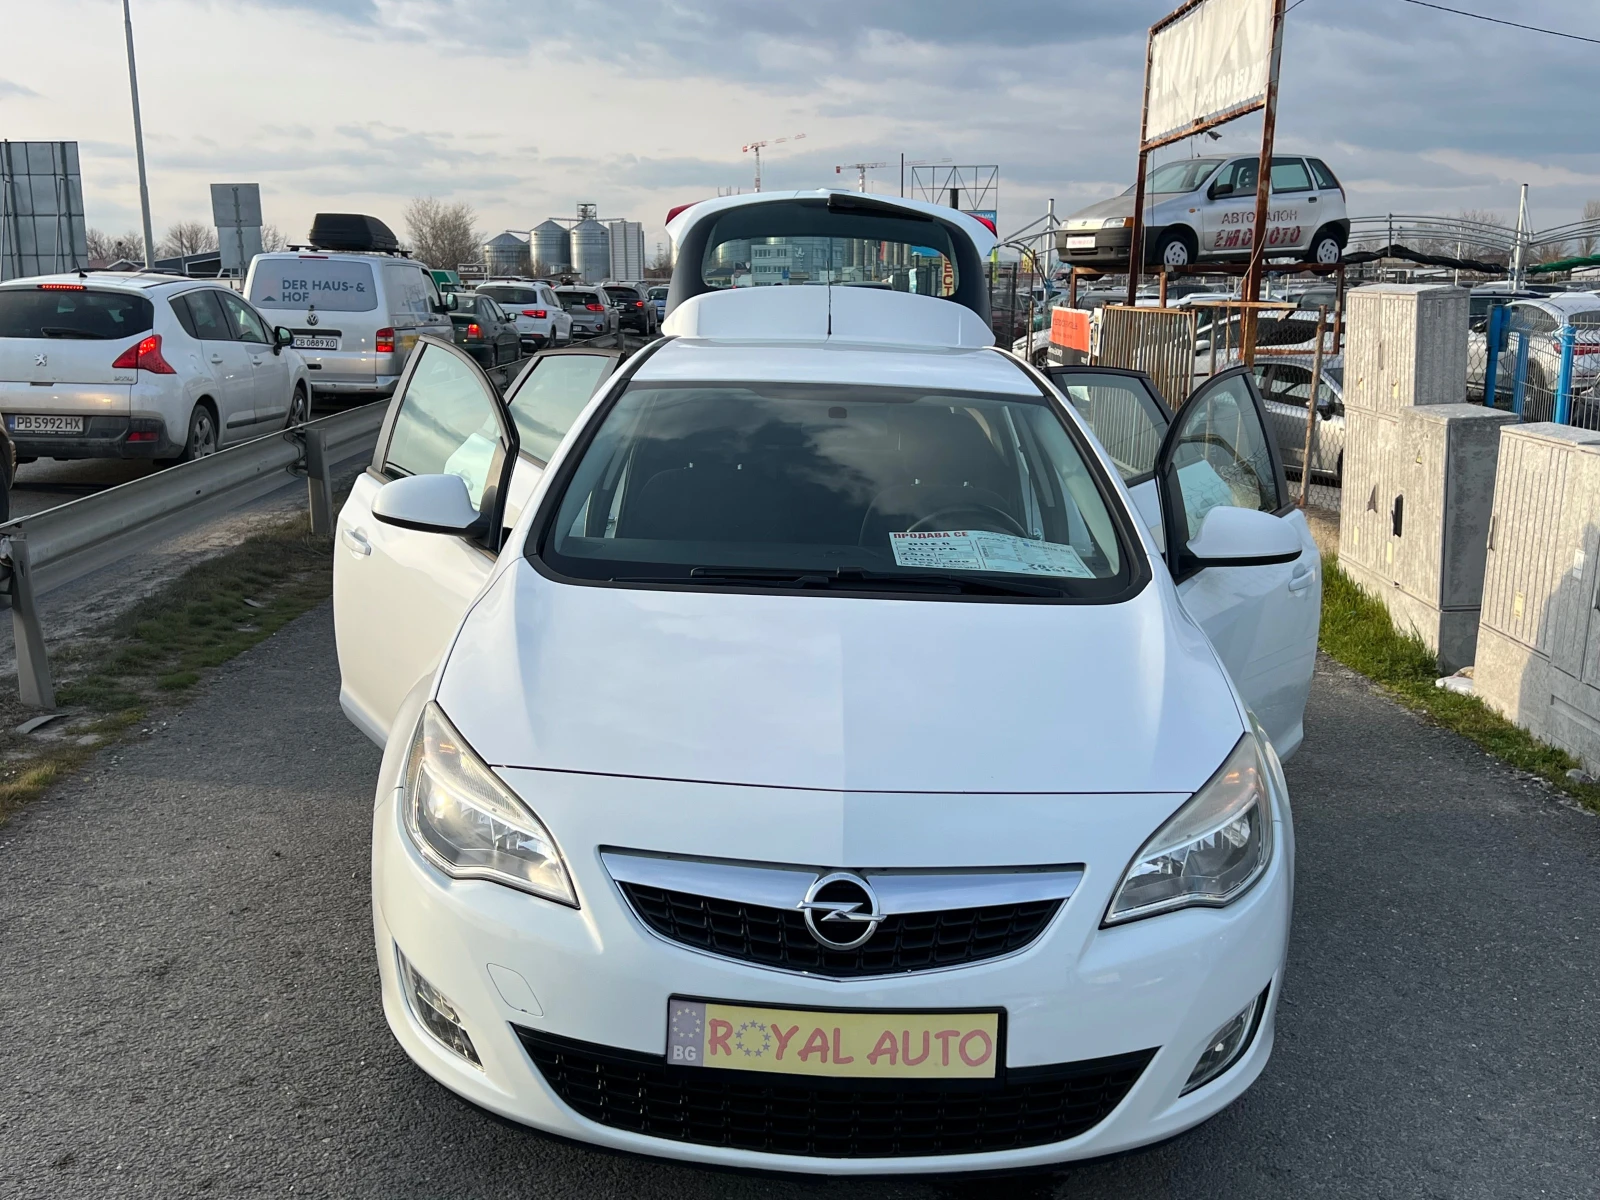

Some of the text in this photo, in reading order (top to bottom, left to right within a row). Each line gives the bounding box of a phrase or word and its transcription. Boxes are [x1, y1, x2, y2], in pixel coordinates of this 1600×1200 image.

[1221, 210, 1298, 224] АВТОАЛОН
[282, 279, 366, 293] DER HAUS- &
[282, 291, 309, 302] HOF
[17, 416, 32, 429] PB
[34, 417, 63, 429] 5992
[65, 418, 81, 430] HX
[893, 531, 951, 540] ПРОДАВА
[672, 1044, 697, 1061] BG
[866, 1028, 993, 1068] AUTO
